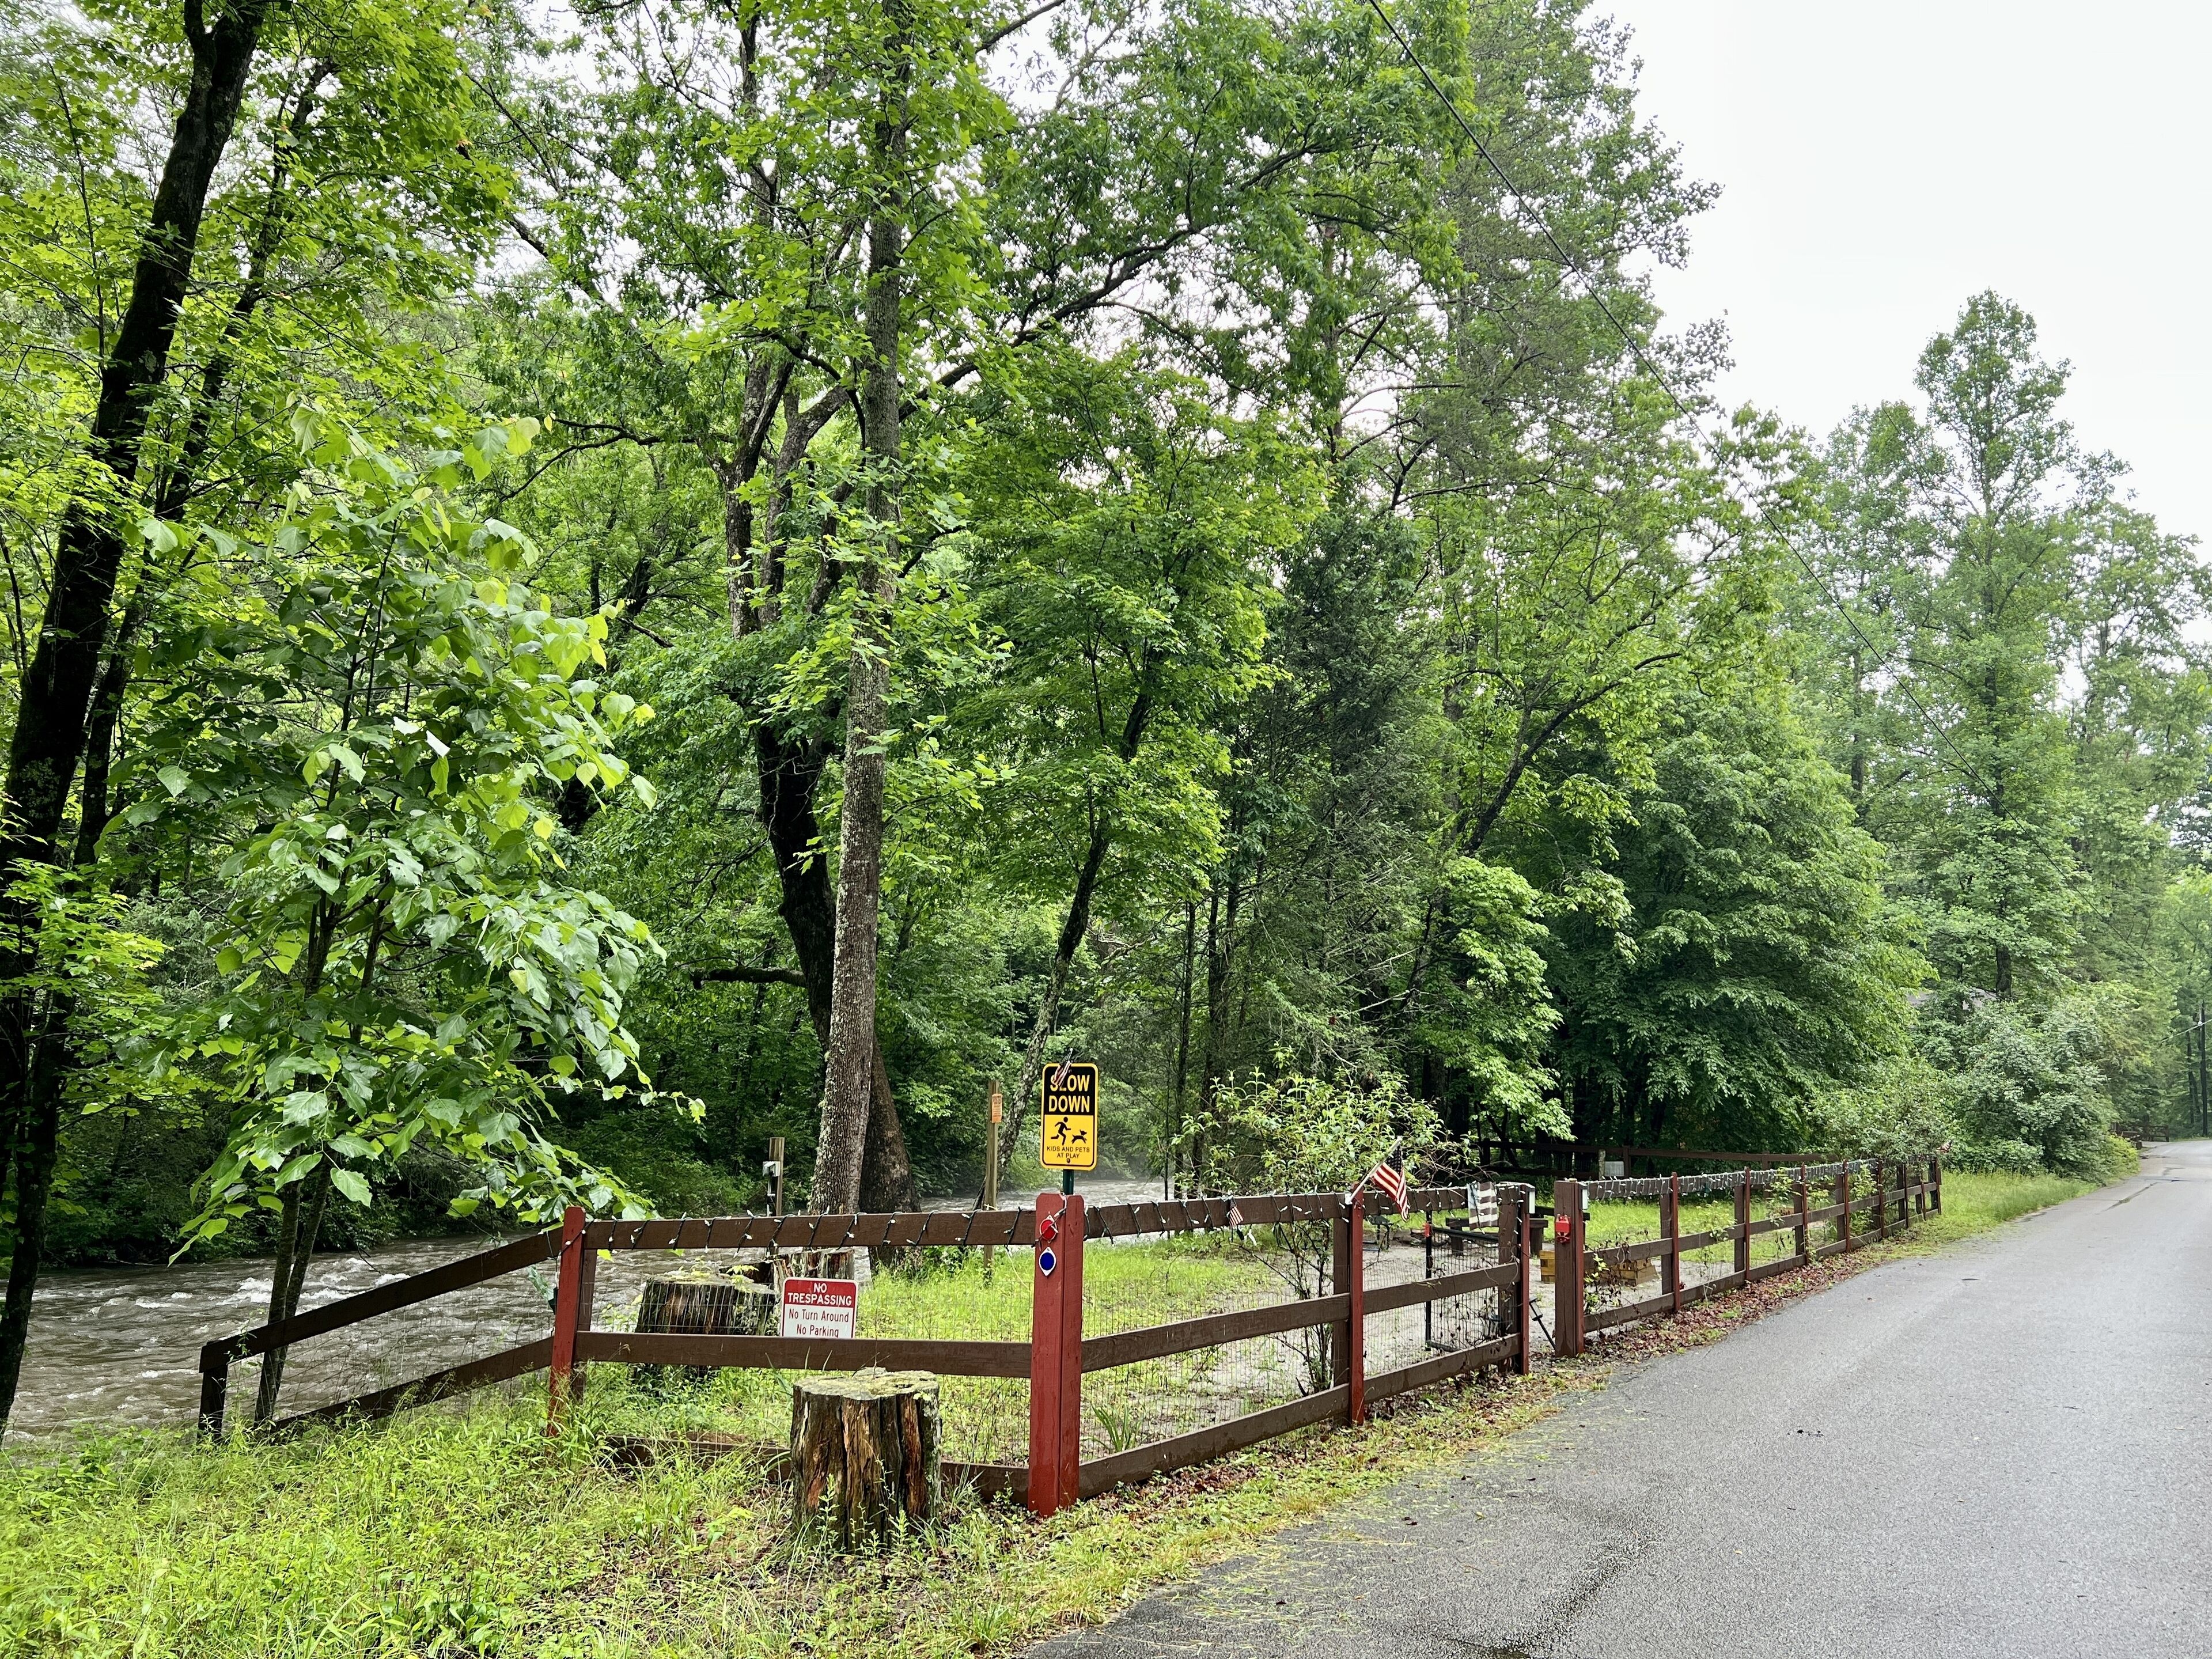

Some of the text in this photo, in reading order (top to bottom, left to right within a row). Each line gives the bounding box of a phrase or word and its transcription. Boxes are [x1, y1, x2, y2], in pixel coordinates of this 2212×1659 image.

[1049, 1095, 1090, 1112] DOWN
[813, 1282, 827, 1293] NO
[787, 1292, 852, 1306] TRESPASSING
[789, 1308, 849, 1323] No Turn Around
[797, 1324, 839, 1338] No Parking
